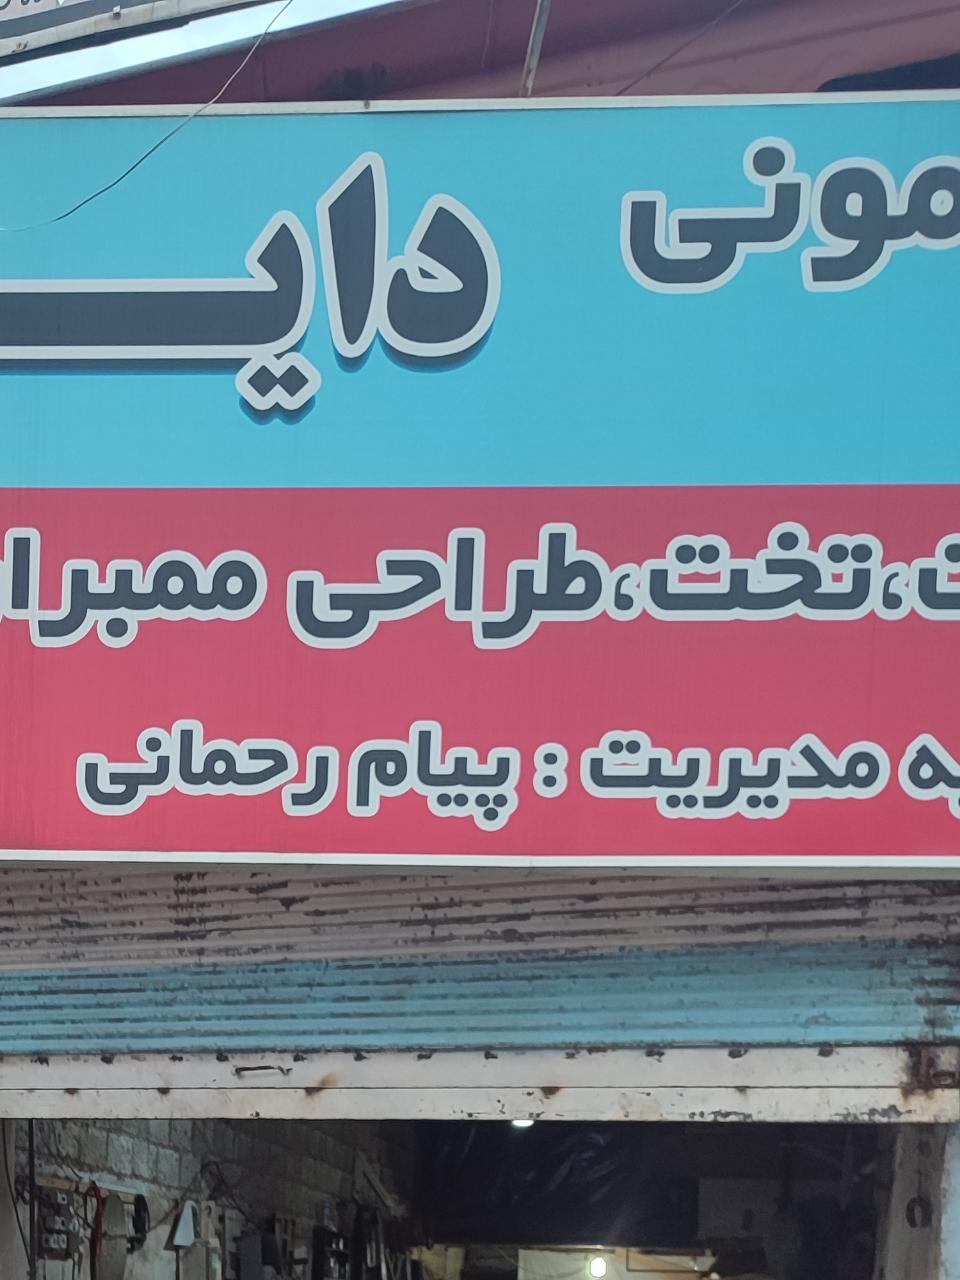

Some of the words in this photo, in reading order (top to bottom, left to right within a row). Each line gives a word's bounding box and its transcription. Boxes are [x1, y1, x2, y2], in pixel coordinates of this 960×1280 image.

[621, 137, 960, 294] مونی
[77, 720, 337, 816] رحمانی
[348, 721, 519, 831] پیام
[581, 730, 890, 818] مدیریت
